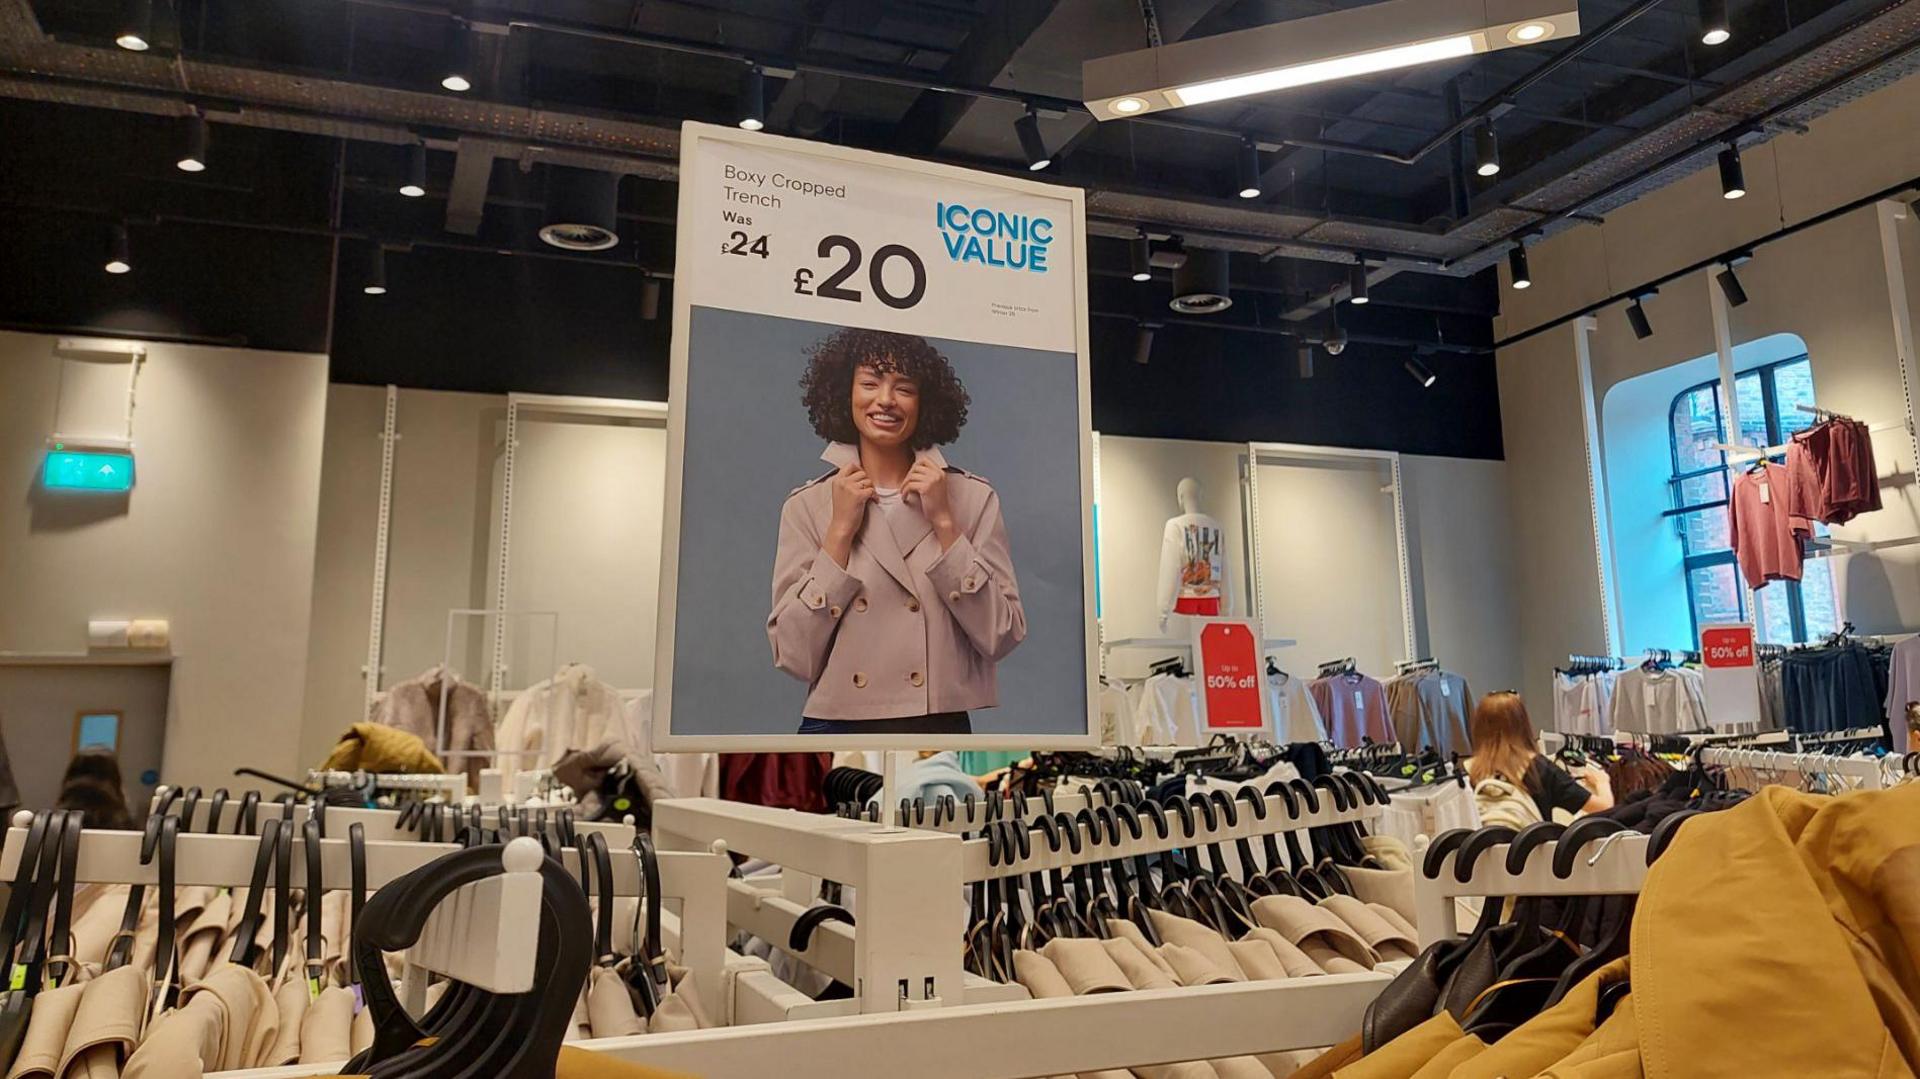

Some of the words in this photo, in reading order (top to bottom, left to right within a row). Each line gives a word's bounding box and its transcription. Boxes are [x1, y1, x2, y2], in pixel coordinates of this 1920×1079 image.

[724, 164, 766, 187] Boxy
[772, 173, 846, 198] Cropped
[723, 186, 781, 208] Trench
[722, 210, 753, 225] Was
[937, 202, 1054, 244] ICONIC
[721, 231, 770, 259] £24
[942, 231, 1048, 272] VALUE
[794, 235, 927, 309] £20
[1711, 647, 1735, 659] 50%
[1736, 645, 1748, 657] off
[1207, 675, 1237, 688] 50%
[1238, 675, 1255, 688] off
